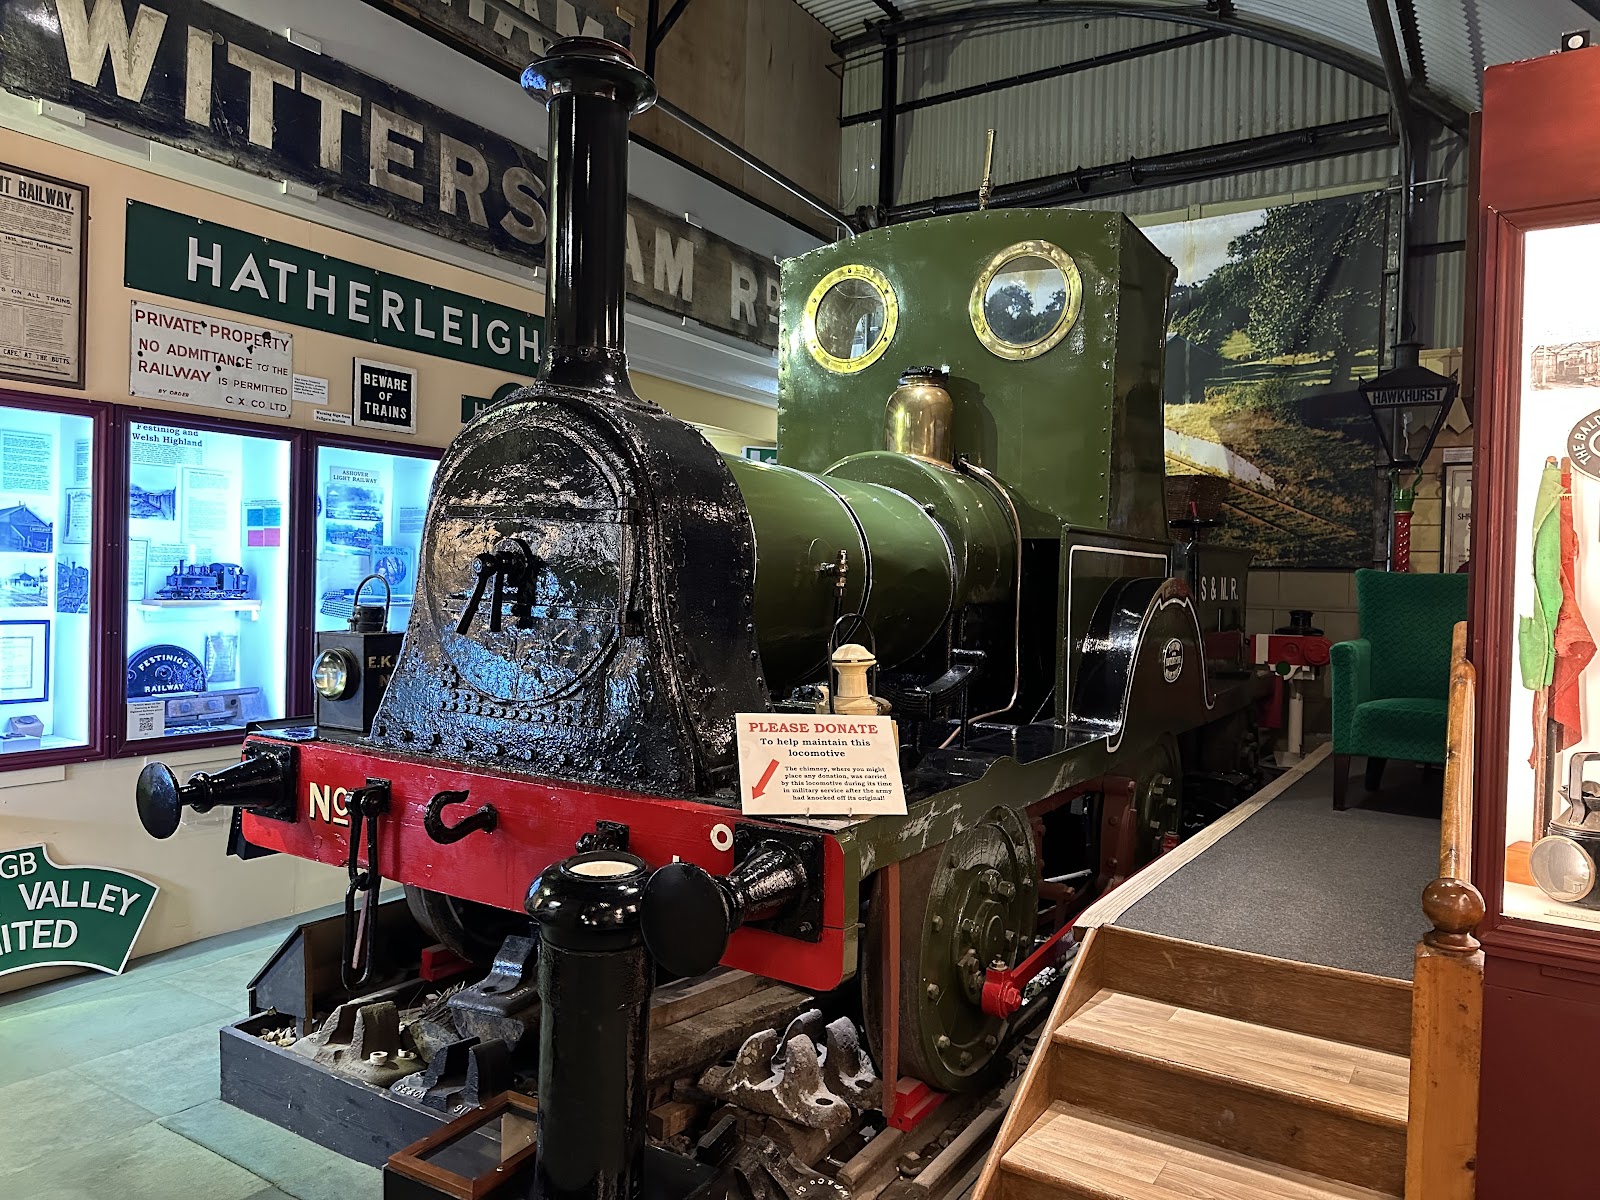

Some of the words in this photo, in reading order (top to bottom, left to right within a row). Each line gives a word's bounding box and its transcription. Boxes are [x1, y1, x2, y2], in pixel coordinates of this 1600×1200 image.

[19, 180, 74, 210] RAILWAY.
[187, 236, 540, 363] HATHERLEIGH
[136, 310, 202, 335] PRIVATE
[210, 324, 290, 352] PROPERTY
[139, 338, 160, 352] NO
[167, 344, 253, 370] ADMITTANCE
[257, 363, 268, 372] TO
[272, 365, 288, 376] THE
[138, 360, 211, 383] RAILWAY
[218, 377, 228, 386] IS
[234, 380, 288, 396] PERMITTED
[364, 373, 407, 391] BEWARE
[379, 392, 393, 402] OF
[1373, 389, 1443, 404] HAWKHURST
[364, 402, 407, 419] TRAINS
[137, 424, 180, 436] Festiniog
[132, 433, 160, 442] Welsh
[163, 436, 202, 447] Highland
[1573, 444, 1591, 465] THE
[144, 683, 184, 693] RAILWAY
[749, 723, 810, 733] PLEASE
[814, 723, 878, 734] DONATE
[777, 738, 798, 747] help
[18, 880, 141, 916] VALLEY
[0, 919, 78, 956] ITED
